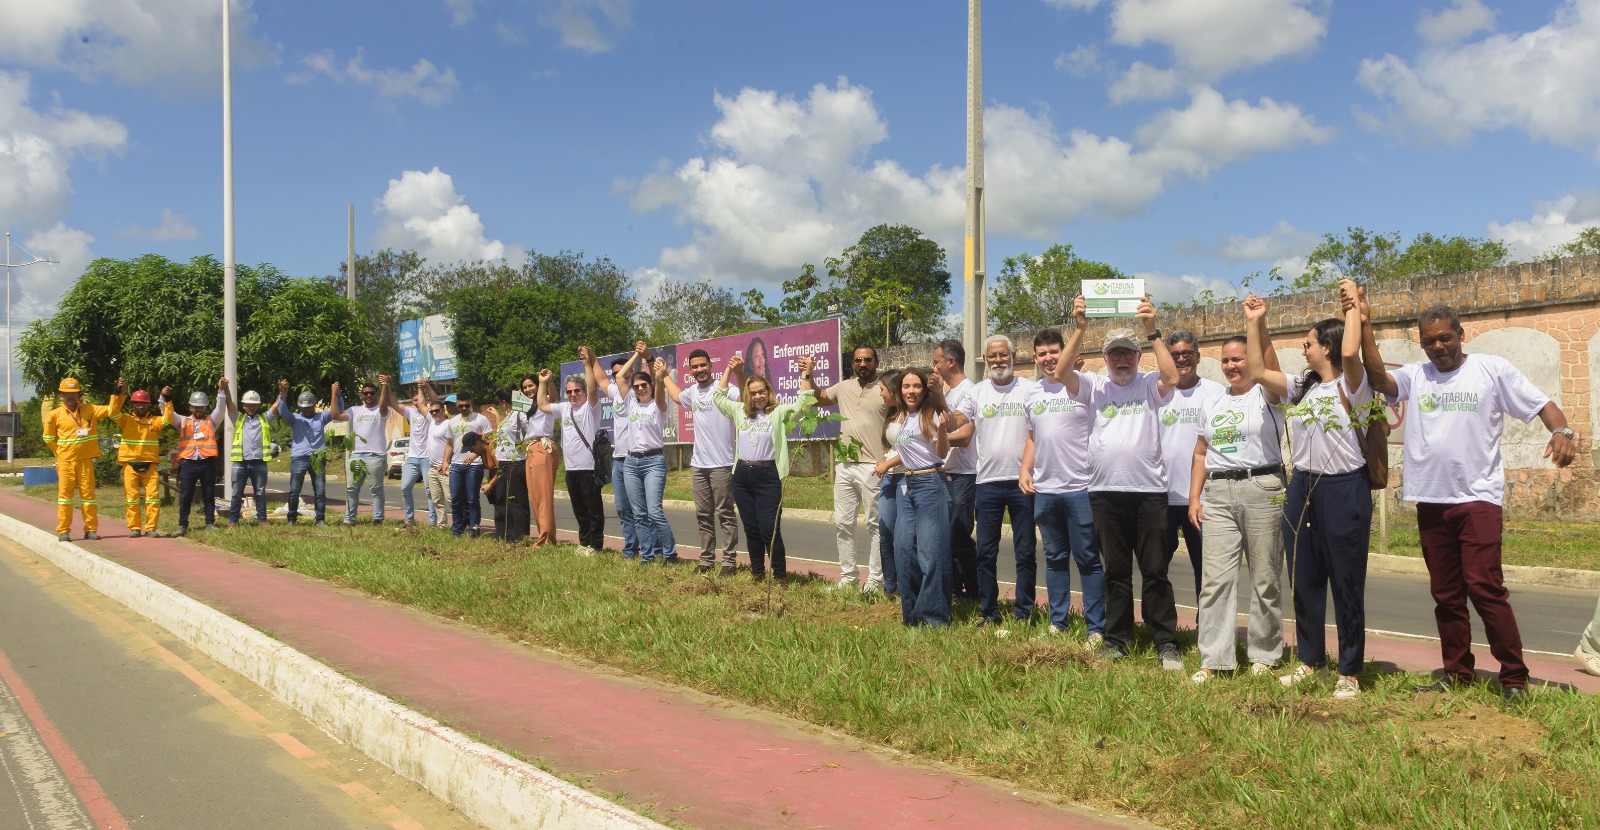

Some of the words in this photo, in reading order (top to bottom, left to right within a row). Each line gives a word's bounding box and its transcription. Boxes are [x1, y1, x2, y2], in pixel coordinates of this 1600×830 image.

[1110, 282, 1135, 290] ITABUNA
[773, 341, 829, 358] Enfermagem
[788, 356, 830, 373] Facia
[1441, 391, 1479, 403] ITABUNA
[1441, 403, 1457, 412] MAIS
[1457, 402, 1479, 412] VERDE
